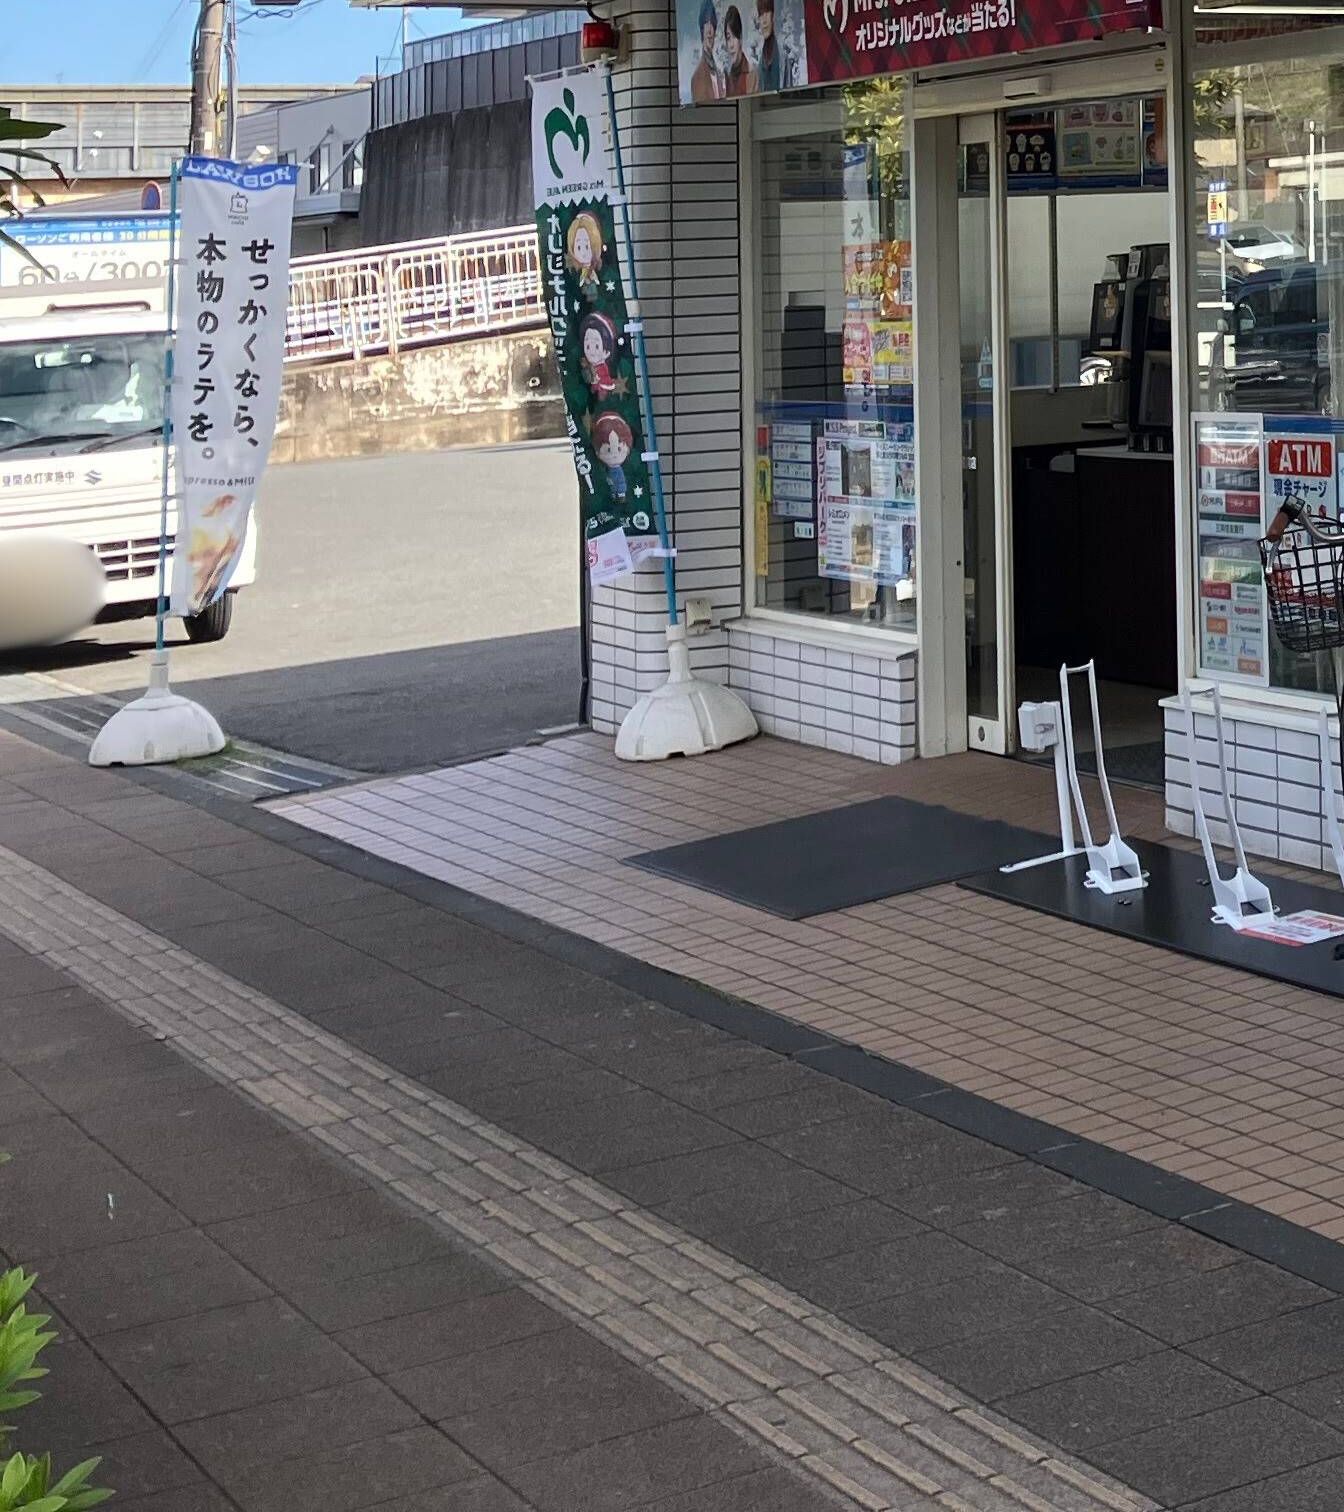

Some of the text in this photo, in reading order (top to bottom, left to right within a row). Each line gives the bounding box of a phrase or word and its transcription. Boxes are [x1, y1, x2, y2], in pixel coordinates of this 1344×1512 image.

[188, 232, 227, 460] 本物のラテを。
[234, 238, 275, 447] せっかくなら、
[1273, 477, 1328, 498] 現金チャージ
[1278, 443, 1323, 474] ATM
